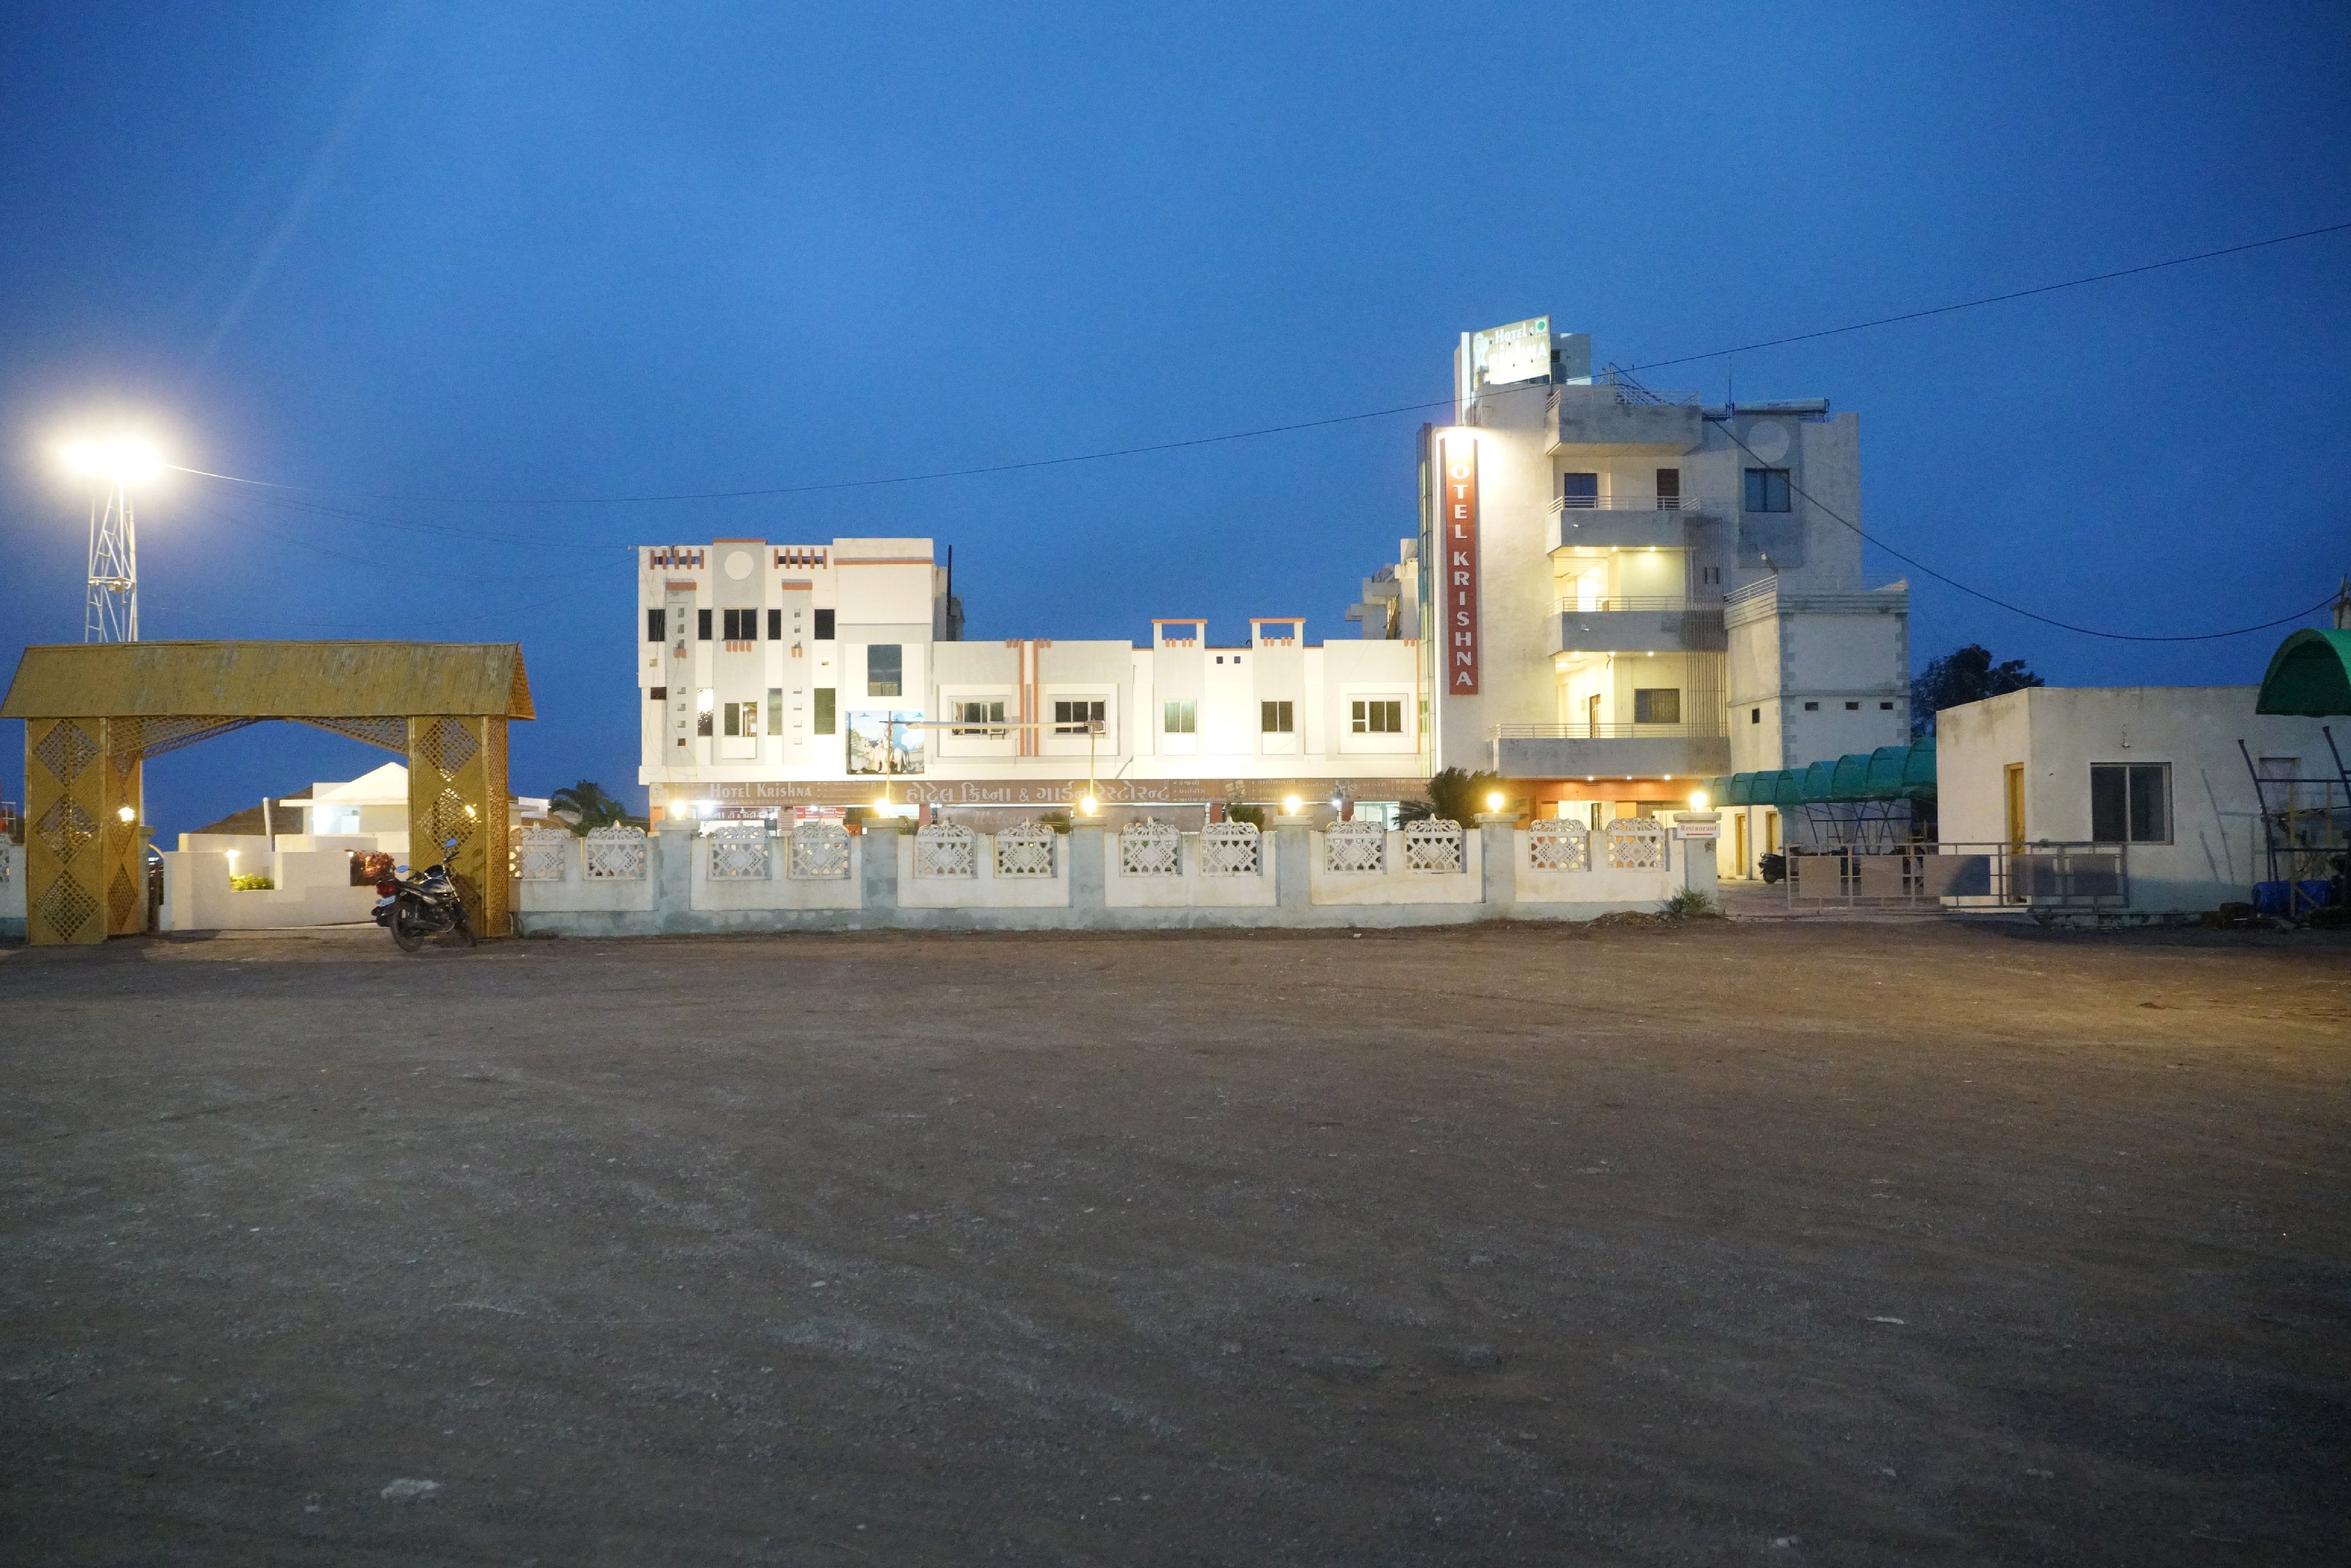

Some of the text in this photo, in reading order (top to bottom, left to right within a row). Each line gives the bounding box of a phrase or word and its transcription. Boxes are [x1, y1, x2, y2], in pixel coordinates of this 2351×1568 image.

[1450, 446, 1473, 686] OTEL KRISHNA
[906, 782, 953, 803] હોટેલ
[1019, 788, 1030, 802] &
[974, 810, 1035, 825] Welcom
